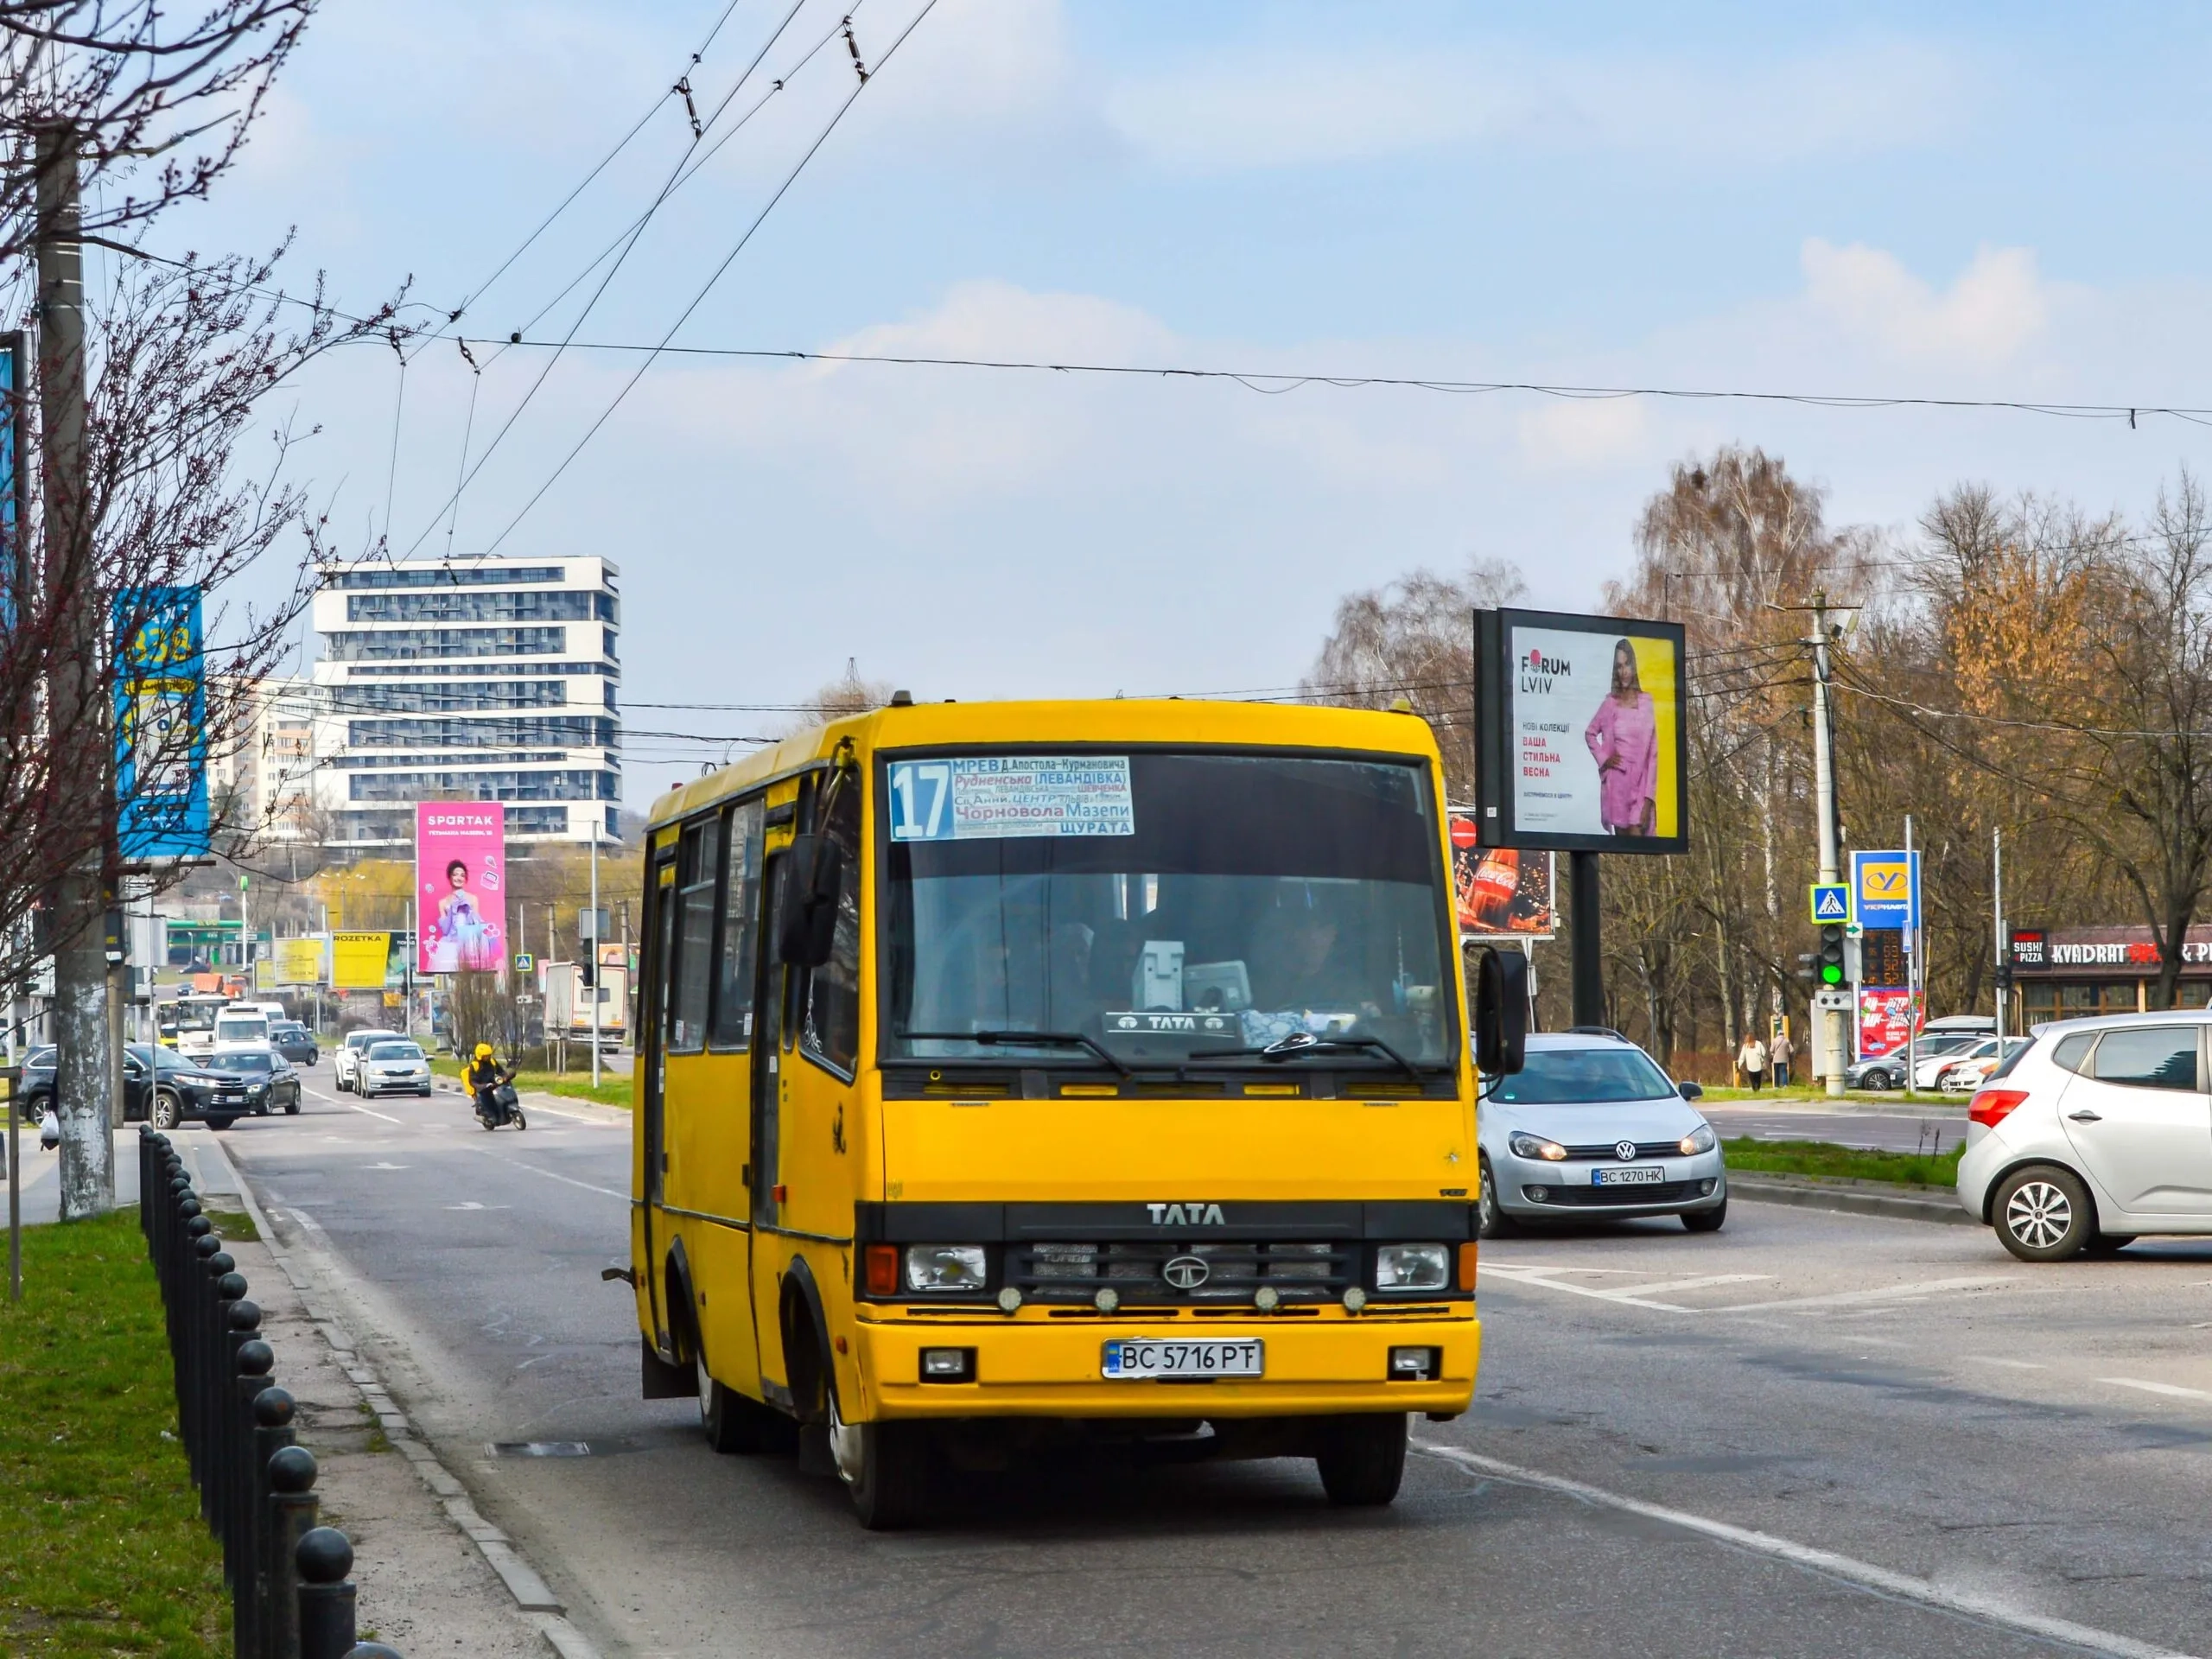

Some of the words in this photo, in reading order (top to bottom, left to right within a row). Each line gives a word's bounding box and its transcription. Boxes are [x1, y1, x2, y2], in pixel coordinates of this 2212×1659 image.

[1521, 676, 1553, 694] LVIV
[1522, 736, 1547, 747] ВАША
[1522, 752, 1560, 764] СТИЛЬНА
[953, 760, 999, 772] МРЕВ
[1523, 766, 1550, 778] ВЕСНА
[955, 773, 1032, 788] Рудненська
[1035, 772, 1127, 785] (ЛЕВАНДІВКА)
[893, 764, 950, 837] 17
[956, 805, 1064, 822] Чорновола
[1065, 803, 1129, 817] Мазепи
[1060, 822, 1130, 834] ЩУРАТА
[2014, 942, 2043, 952] SUSHI
[2051, 944, 2126, 963] KVADRAT
[2019, 952, 2044, 963] PIZZA
[1148, 1016, 1195, 1029] TATA
[1600, 1173, 1616, 1183] BC
[1620, 1171, 1643, 1182] 1270
[1646, 1170, 1662, 1181] HK
[1147, 1203, 1225, 1225] TATA
[1123, 1347, 1155, 1369] BC
[1163, 1346, 1215, 1369] 5716
[1223, 1346, 1255, 1369] PT
